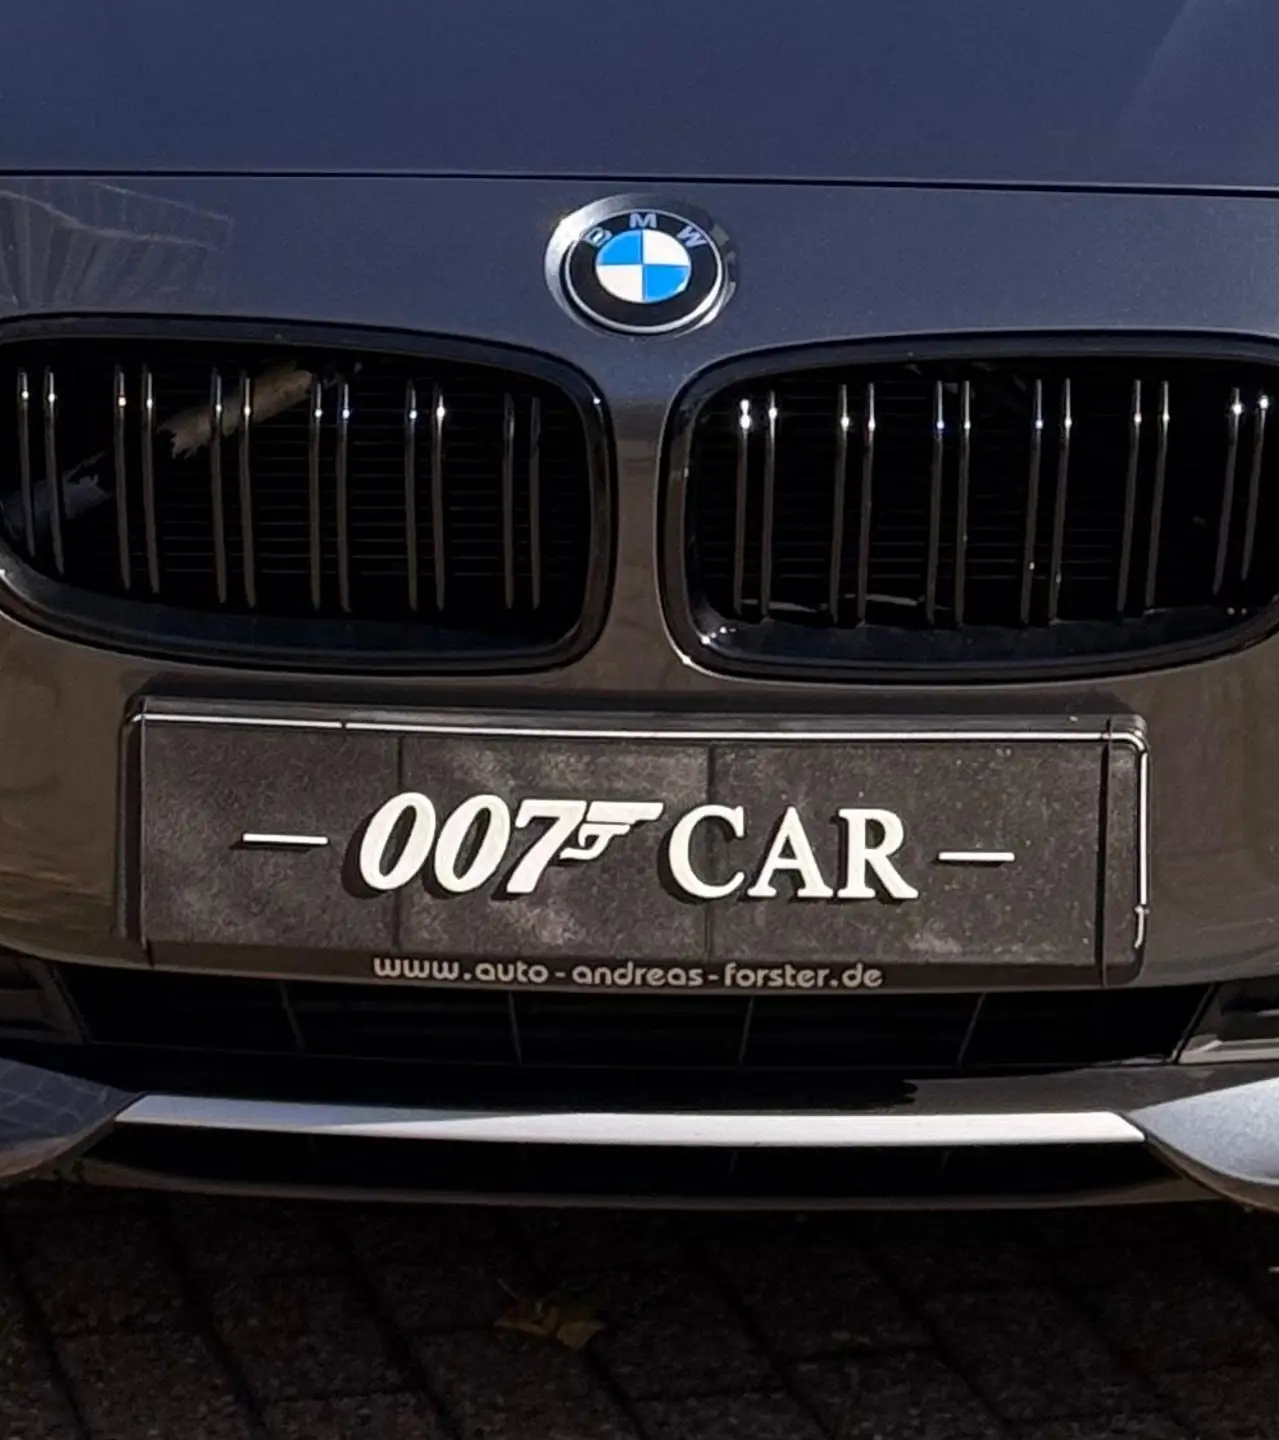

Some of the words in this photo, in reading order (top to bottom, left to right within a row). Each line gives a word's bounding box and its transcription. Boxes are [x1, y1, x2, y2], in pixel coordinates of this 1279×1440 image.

[585, 212, 708, 248] BMW
[359, 792, 664, 894] 007
[668, 804, 919, 899] CAR
